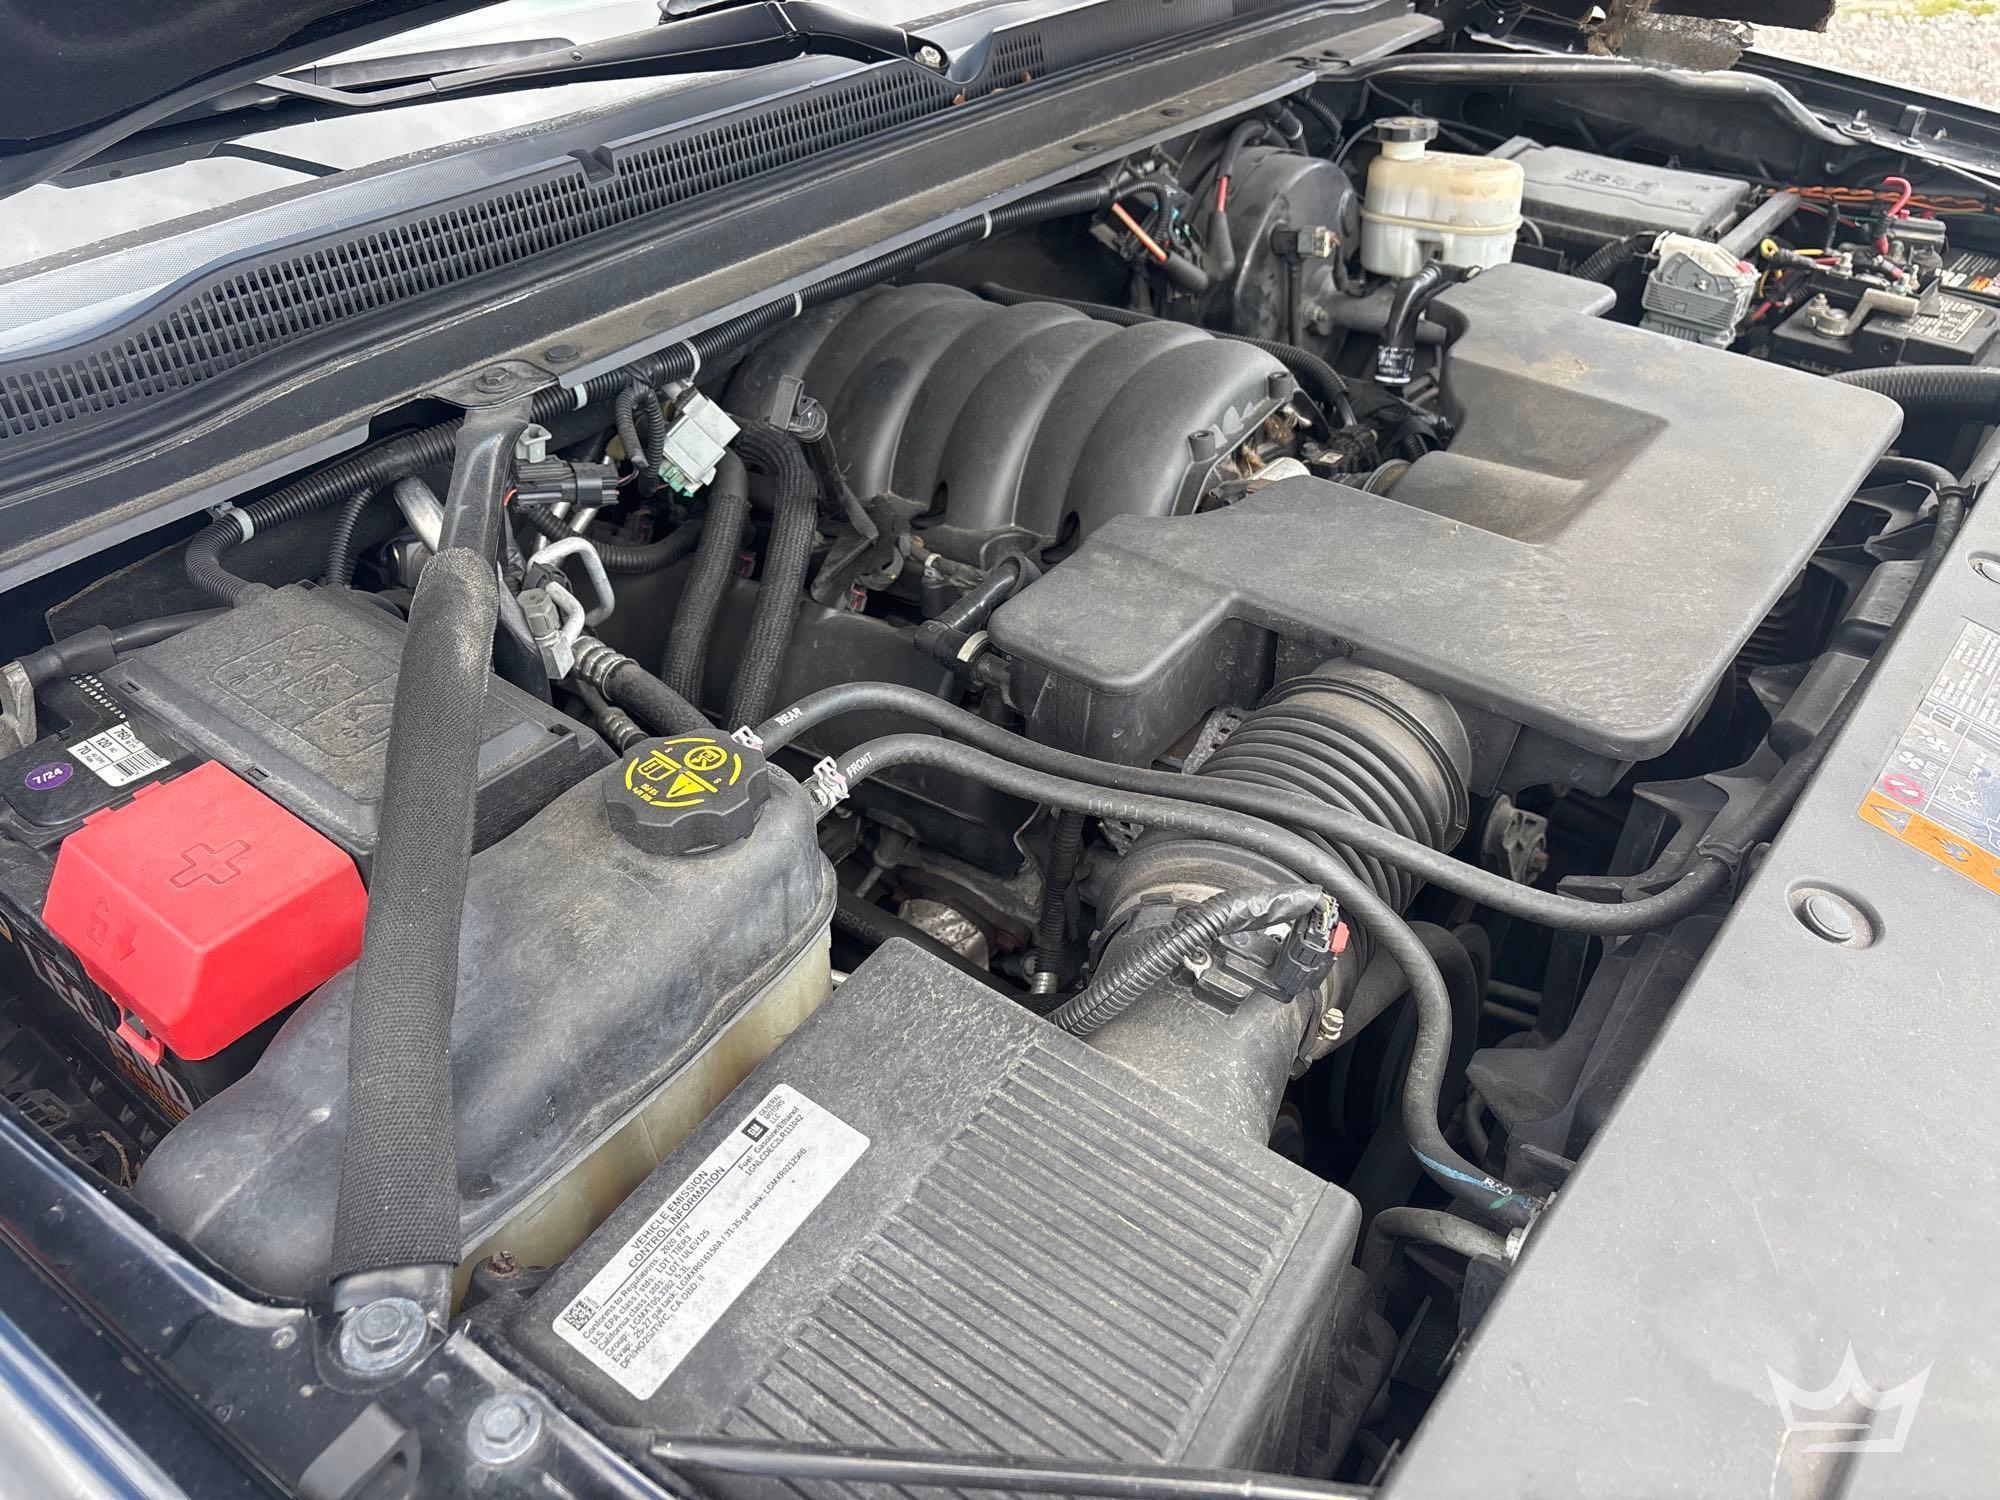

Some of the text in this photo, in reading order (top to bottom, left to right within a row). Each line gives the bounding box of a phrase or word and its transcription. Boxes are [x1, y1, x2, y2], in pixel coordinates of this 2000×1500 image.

[775, 707, 803, 727] REAR
[95, 737, 113, 750] 120
[114, 728, 132, 741] 760
[76, 745, 92, 755] 70
[32, 767, 63, 784] 7/24
[846, 751, 873, 779] FRONT
[758, 1094, 781, 1116] GENERAL
[763, 1099, 785, 1119] MOTORS
[769, 1112, 780, 1124] LLC
[737, 1105, 799, 1170] Fuel: Gasoline/Ethanol
[628, 1166, 725, 1267] CONTROL INFORMATION
[630, 1170, 708, 1248] VEHICLE EMISSION
[611, 1341, 633, 1363] Evap:
[632, 1317, 652, 1339] 25-27
[651, 1306, 663, 1320] gal
[660, 1290, 678, 1308] tank:
[675, 1240, 723, 1290] LGMXR016150A
[723, 1218, 742, 1237] 31-35
[740, 1208, 751, 1221] gal
[748, 1193, 765, 1209] tank:
[762, 1147, 807, 1194] LGMXR021250B
[582, 1304, 616, 1339] Conforms
[621, 1256, 660, 1295] Regulations:
[659, 1237, 676, 1254] 2020
[675, 1222, 689, 1237] FFV
[589, 1330, 605, 1345] U.S.
[603, 1314, 620, 1330] EPA
[618, 1295, 637, 1314] class
[638, 1275, 656, 1292] stds:
[655, 1257, 670, 1273] LDT
[670, 1234, 691, 1254] TIER3
[597, 1316, 630, 1351] California
[628, 1298, 646, 1317] class
[648, 1277, 665, 1295] stds:
[665, 1260, 680, 1276] LDT
[681, 1229, 709, 1258] ULEV125
[604, 1330, 629, 1357] Group:
[673, 1265, 690, 1279] 5.3L
[669, 1300, 683, 1311] CA
